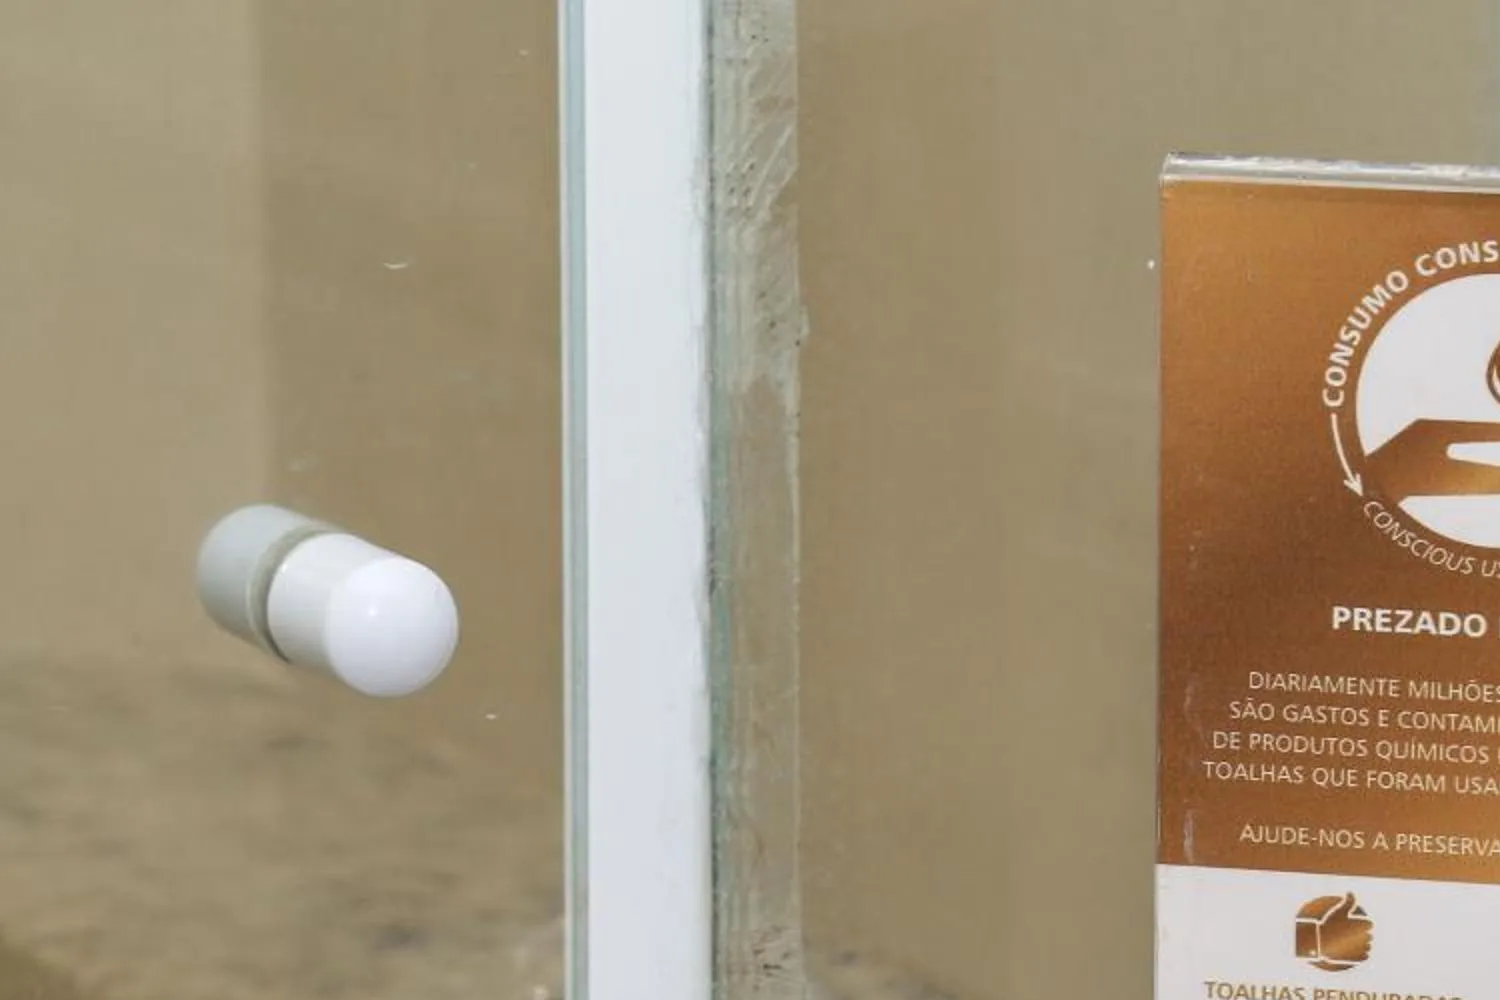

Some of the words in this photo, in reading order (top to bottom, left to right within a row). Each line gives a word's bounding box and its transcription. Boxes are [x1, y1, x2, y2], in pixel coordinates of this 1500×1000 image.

[1322, 271, 1409, 408] CONSUMO
[1363, 500, 1476, 575] CONSCIOUS
[1332, 606, 1487, 637] PREZADO
[1249, 671, 1400, 698] DIARIAMENTE
[1229, 697, 1275, 721] SÃO
[1283, 703, 1370, 727] GASTOS
[1378, 709, 1390, 727] E
[1213, 731, 1241, 750] DE
[1250, 733, 1369, 758] PRODUTOS
[1376, 735, 1489, 765] QUÍMICOS
[1202, 761, 1304, 784] TOALHAS
[1312, 767, 1359, 789] QUE
[1367, 770, 1446, 793] FORAM
[1239, 825, 1366, 850] AJUDE-NOS
[1372, 835, 1389, 851] A
